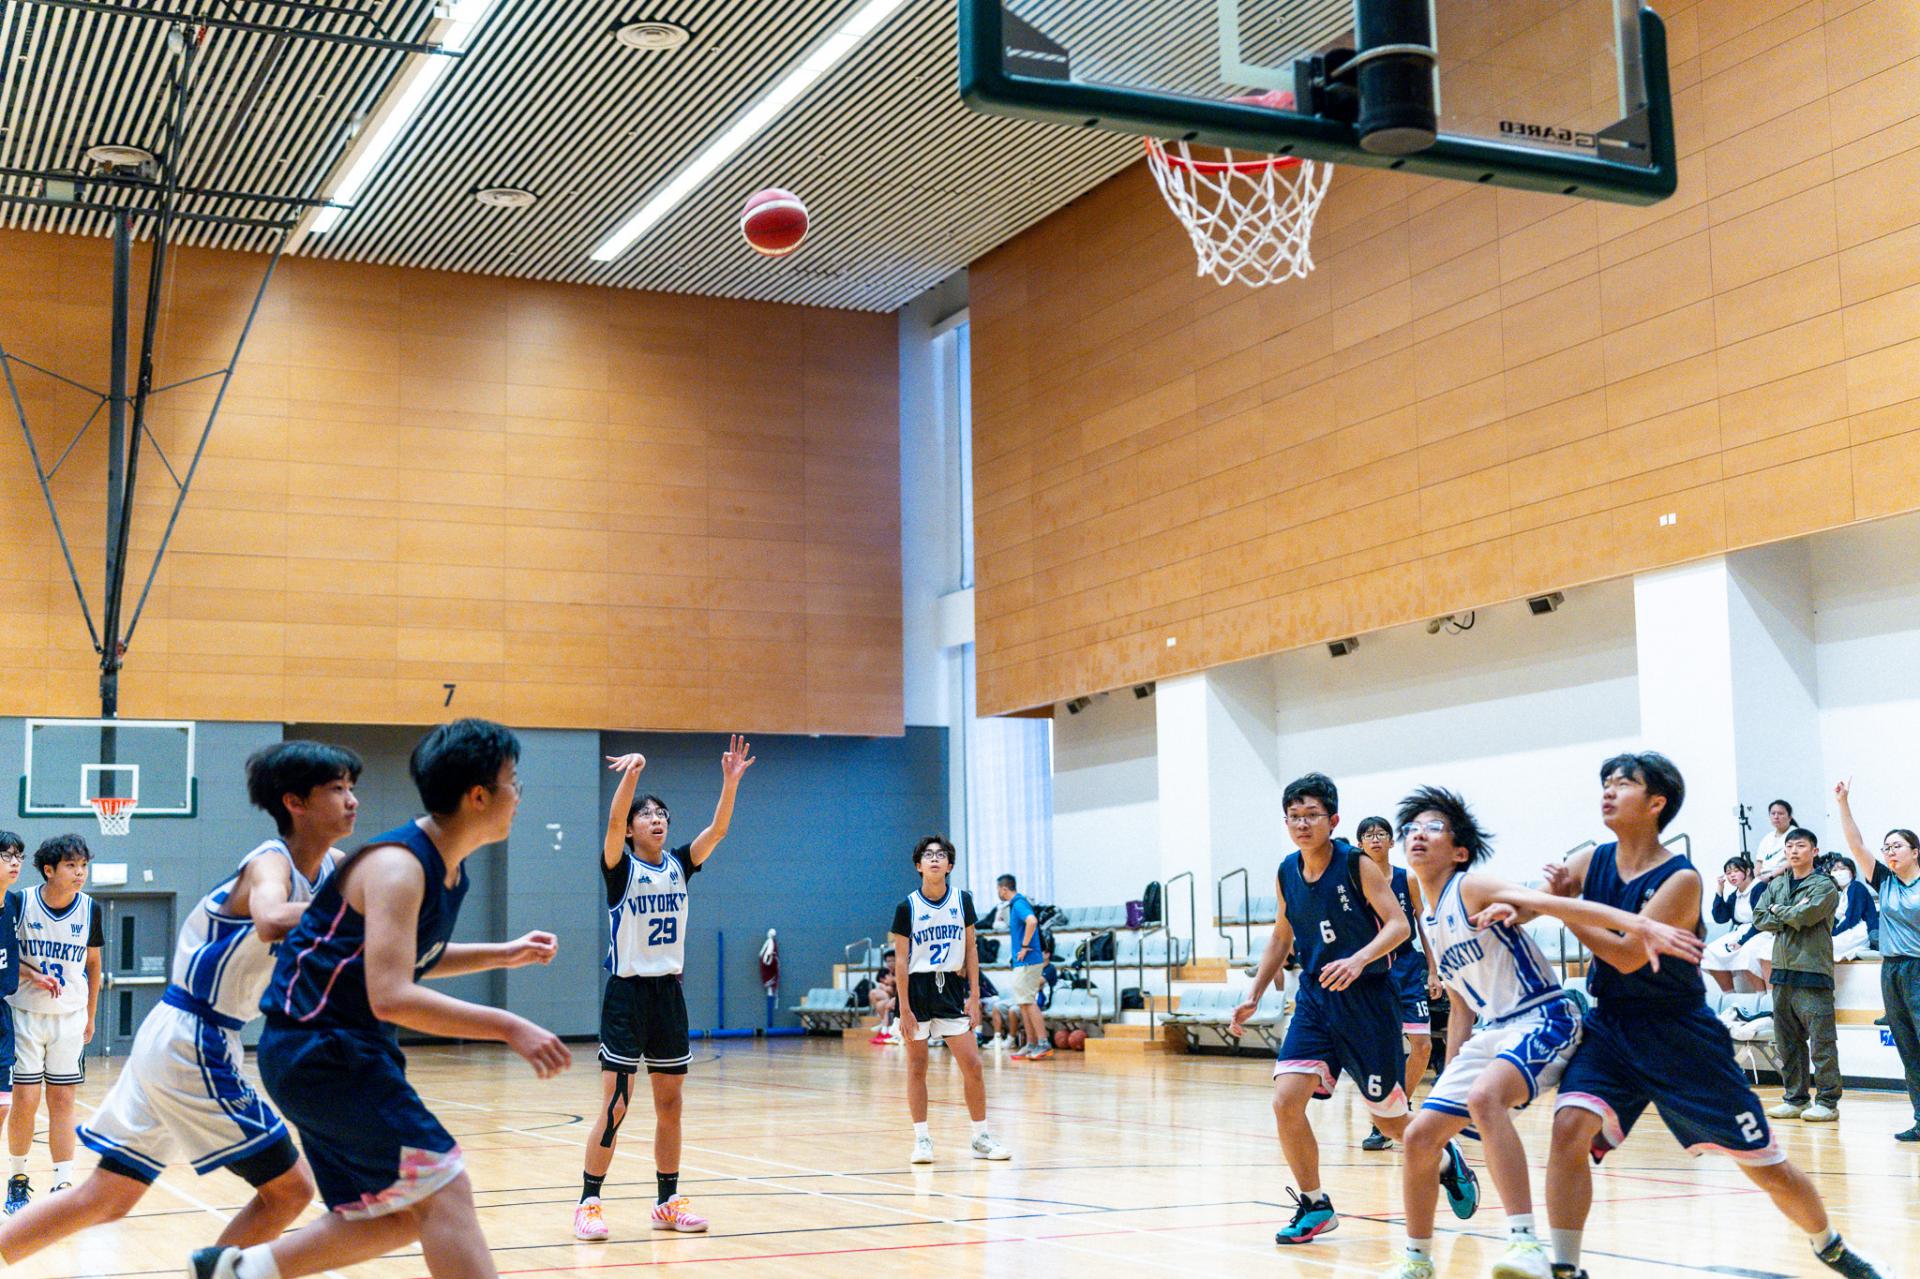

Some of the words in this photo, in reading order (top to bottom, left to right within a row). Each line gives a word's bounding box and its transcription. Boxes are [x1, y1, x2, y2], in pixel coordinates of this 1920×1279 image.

[443, 684, 456, 707] 7
[648, 917, 677, 946] 29
[1320, 920, 1336, 944] 6
[929, 942, 951, 965] 27
[40, 961, 65, 987] 13
[1416, 1001, 1429, 1017] 16
[1368, 1074, 1382, 1097] 6
[1735, 1111, 1763, 1143] 2
